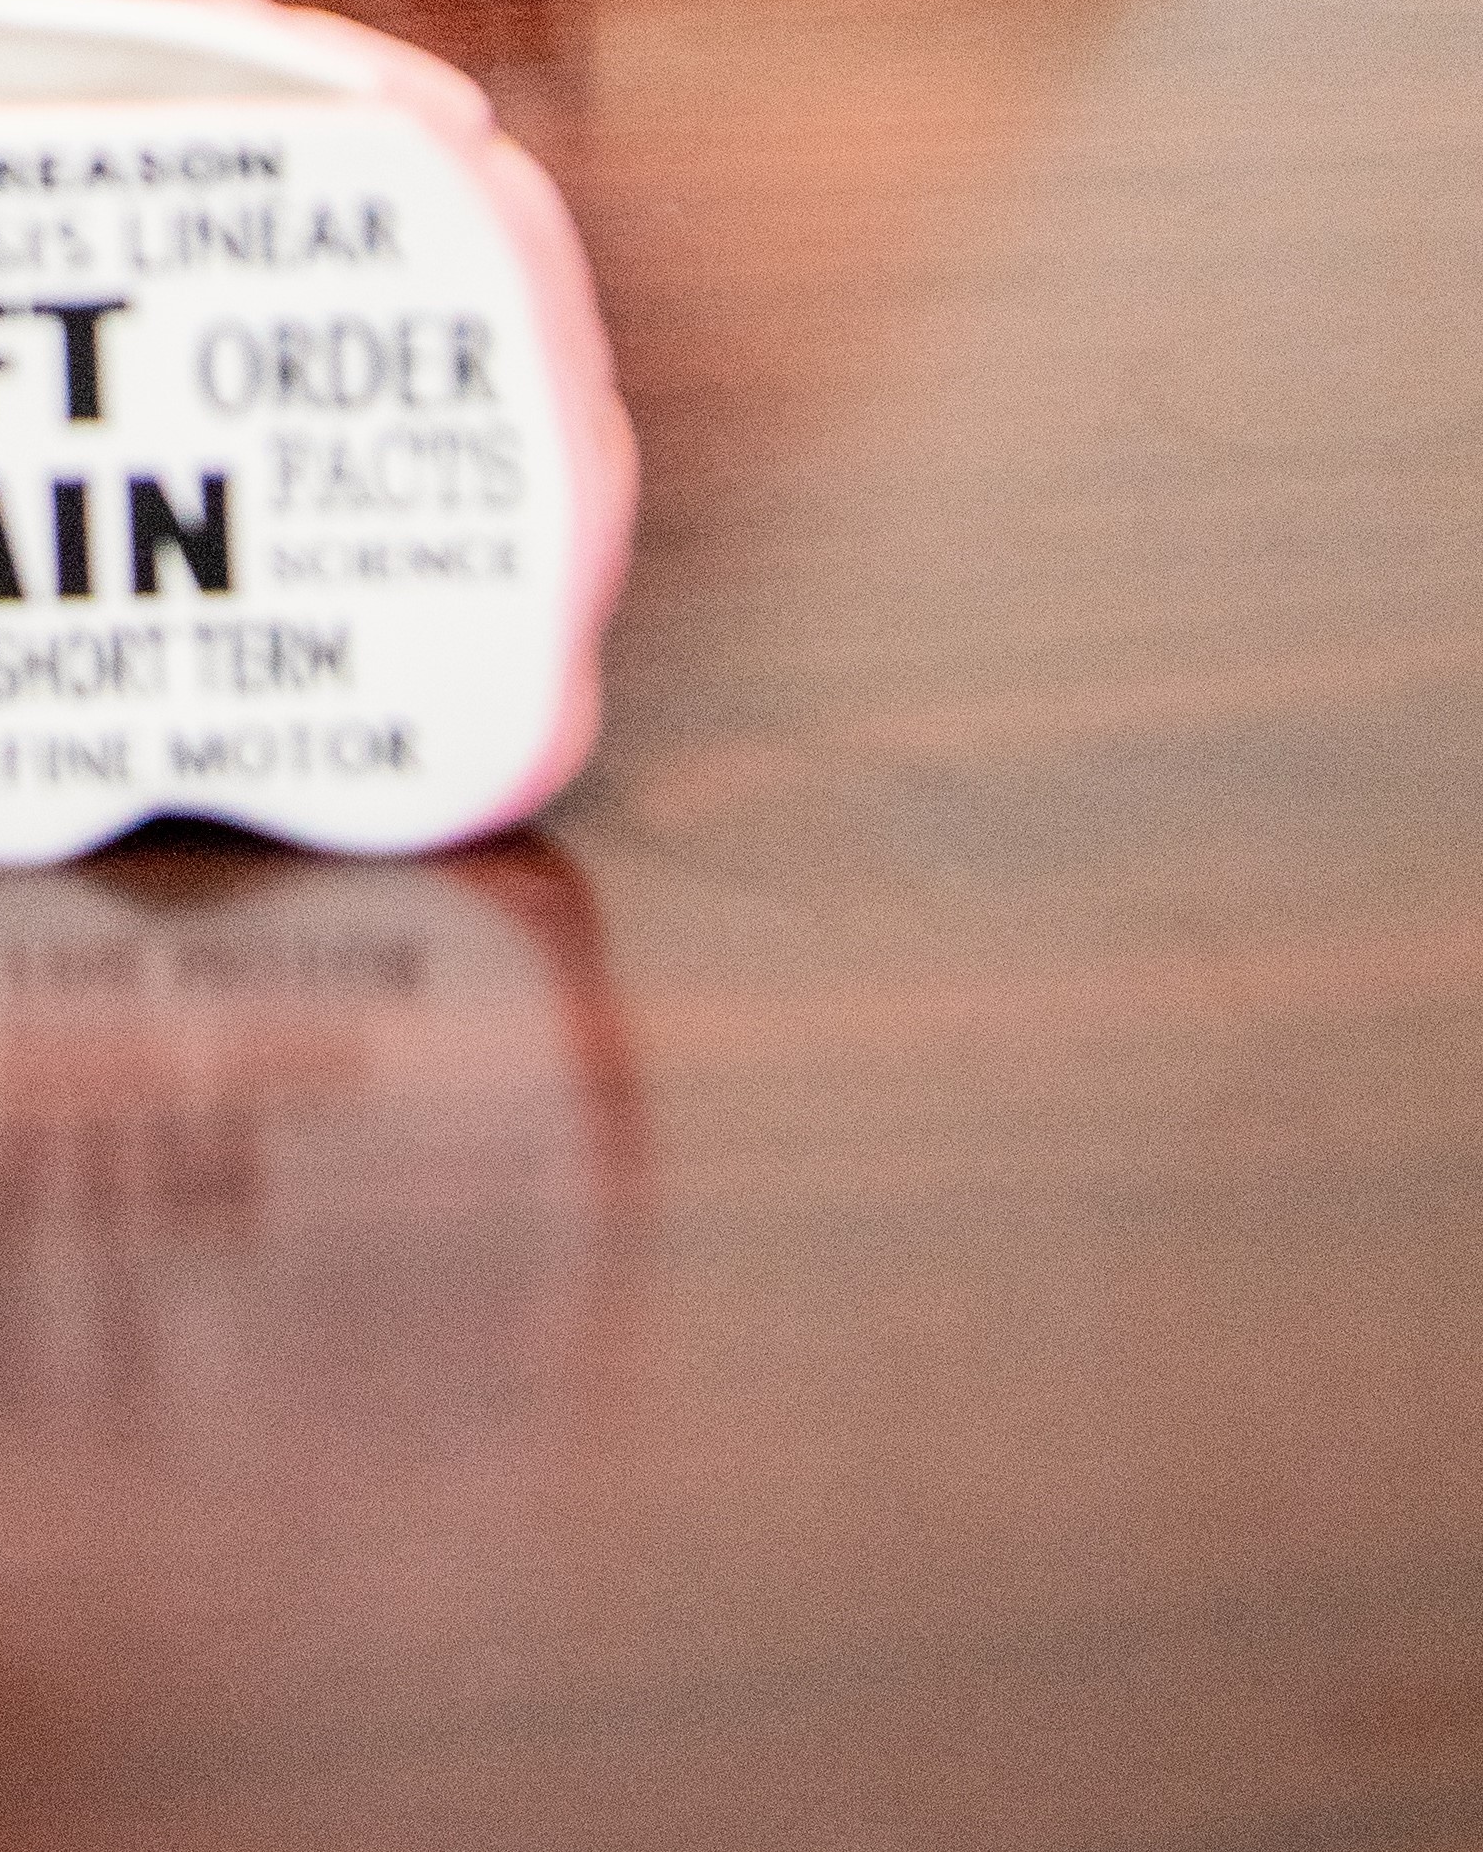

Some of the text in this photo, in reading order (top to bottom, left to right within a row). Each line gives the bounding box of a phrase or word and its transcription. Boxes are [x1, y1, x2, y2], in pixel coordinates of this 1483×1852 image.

[126, 199, 404, 271] LINEAR
[195, 313, 502, 416] ORDER
[271, 425, 525, 517] FACTS
[190, 621, 352, 693] TERM
[168, 717, 416, 777] MOTOR
